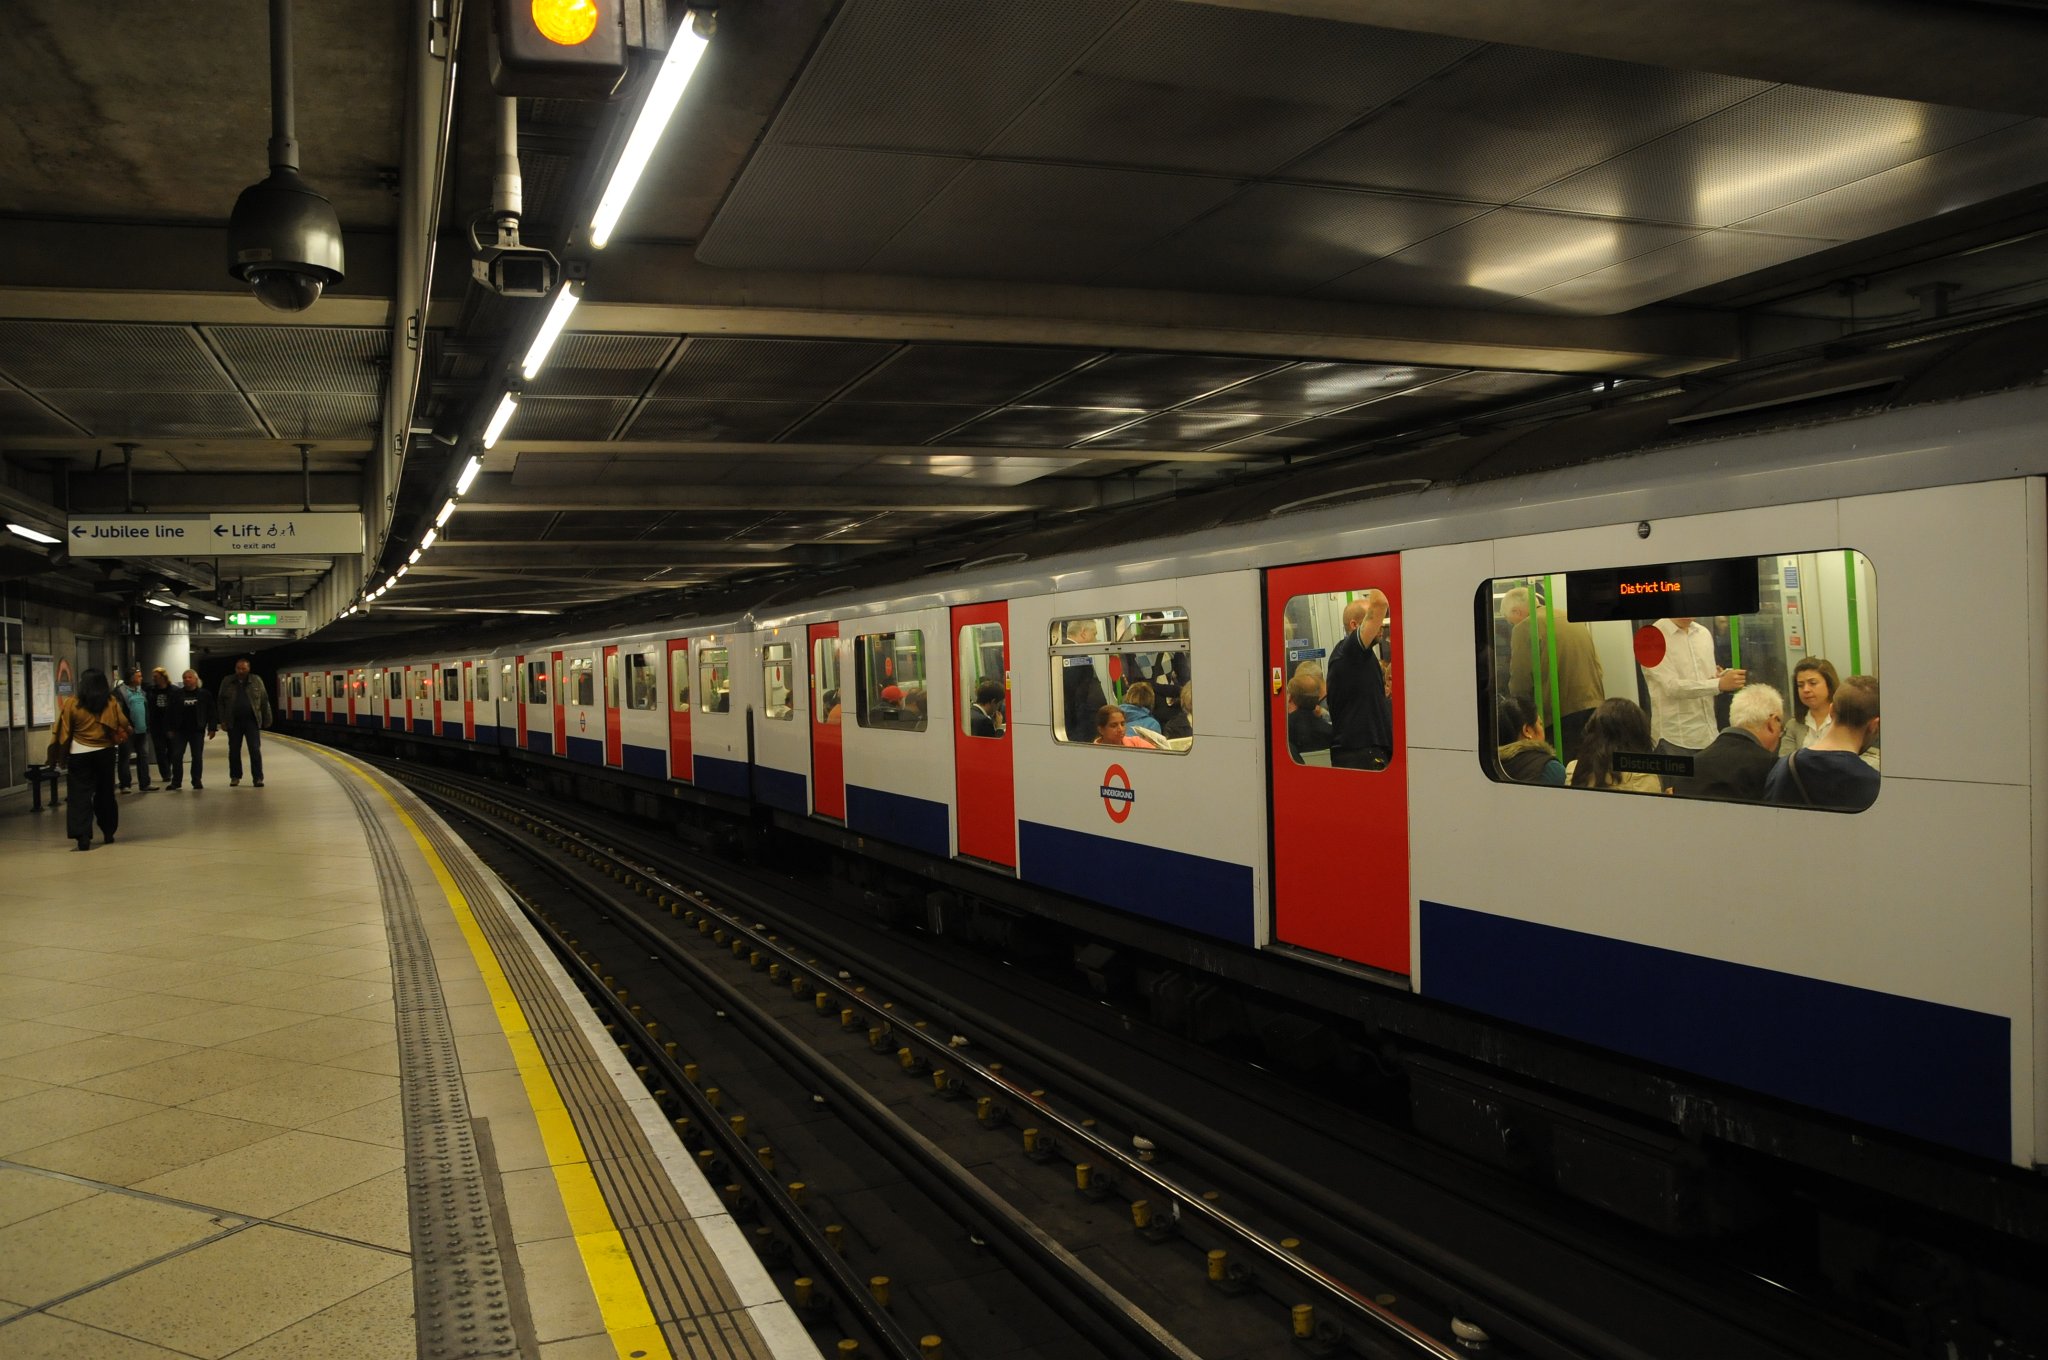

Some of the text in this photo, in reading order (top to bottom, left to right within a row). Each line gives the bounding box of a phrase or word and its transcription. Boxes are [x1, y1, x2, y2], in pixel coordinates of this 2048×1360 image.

[90, 525, 185, 538] Jubilee line
[232, 524, 261, 537] Lift
[1620, 581, 1681, 595] District line
[1620, 757, 1686, 773] District line
[1101, 788, 1133, 799] UNDERGROUND
